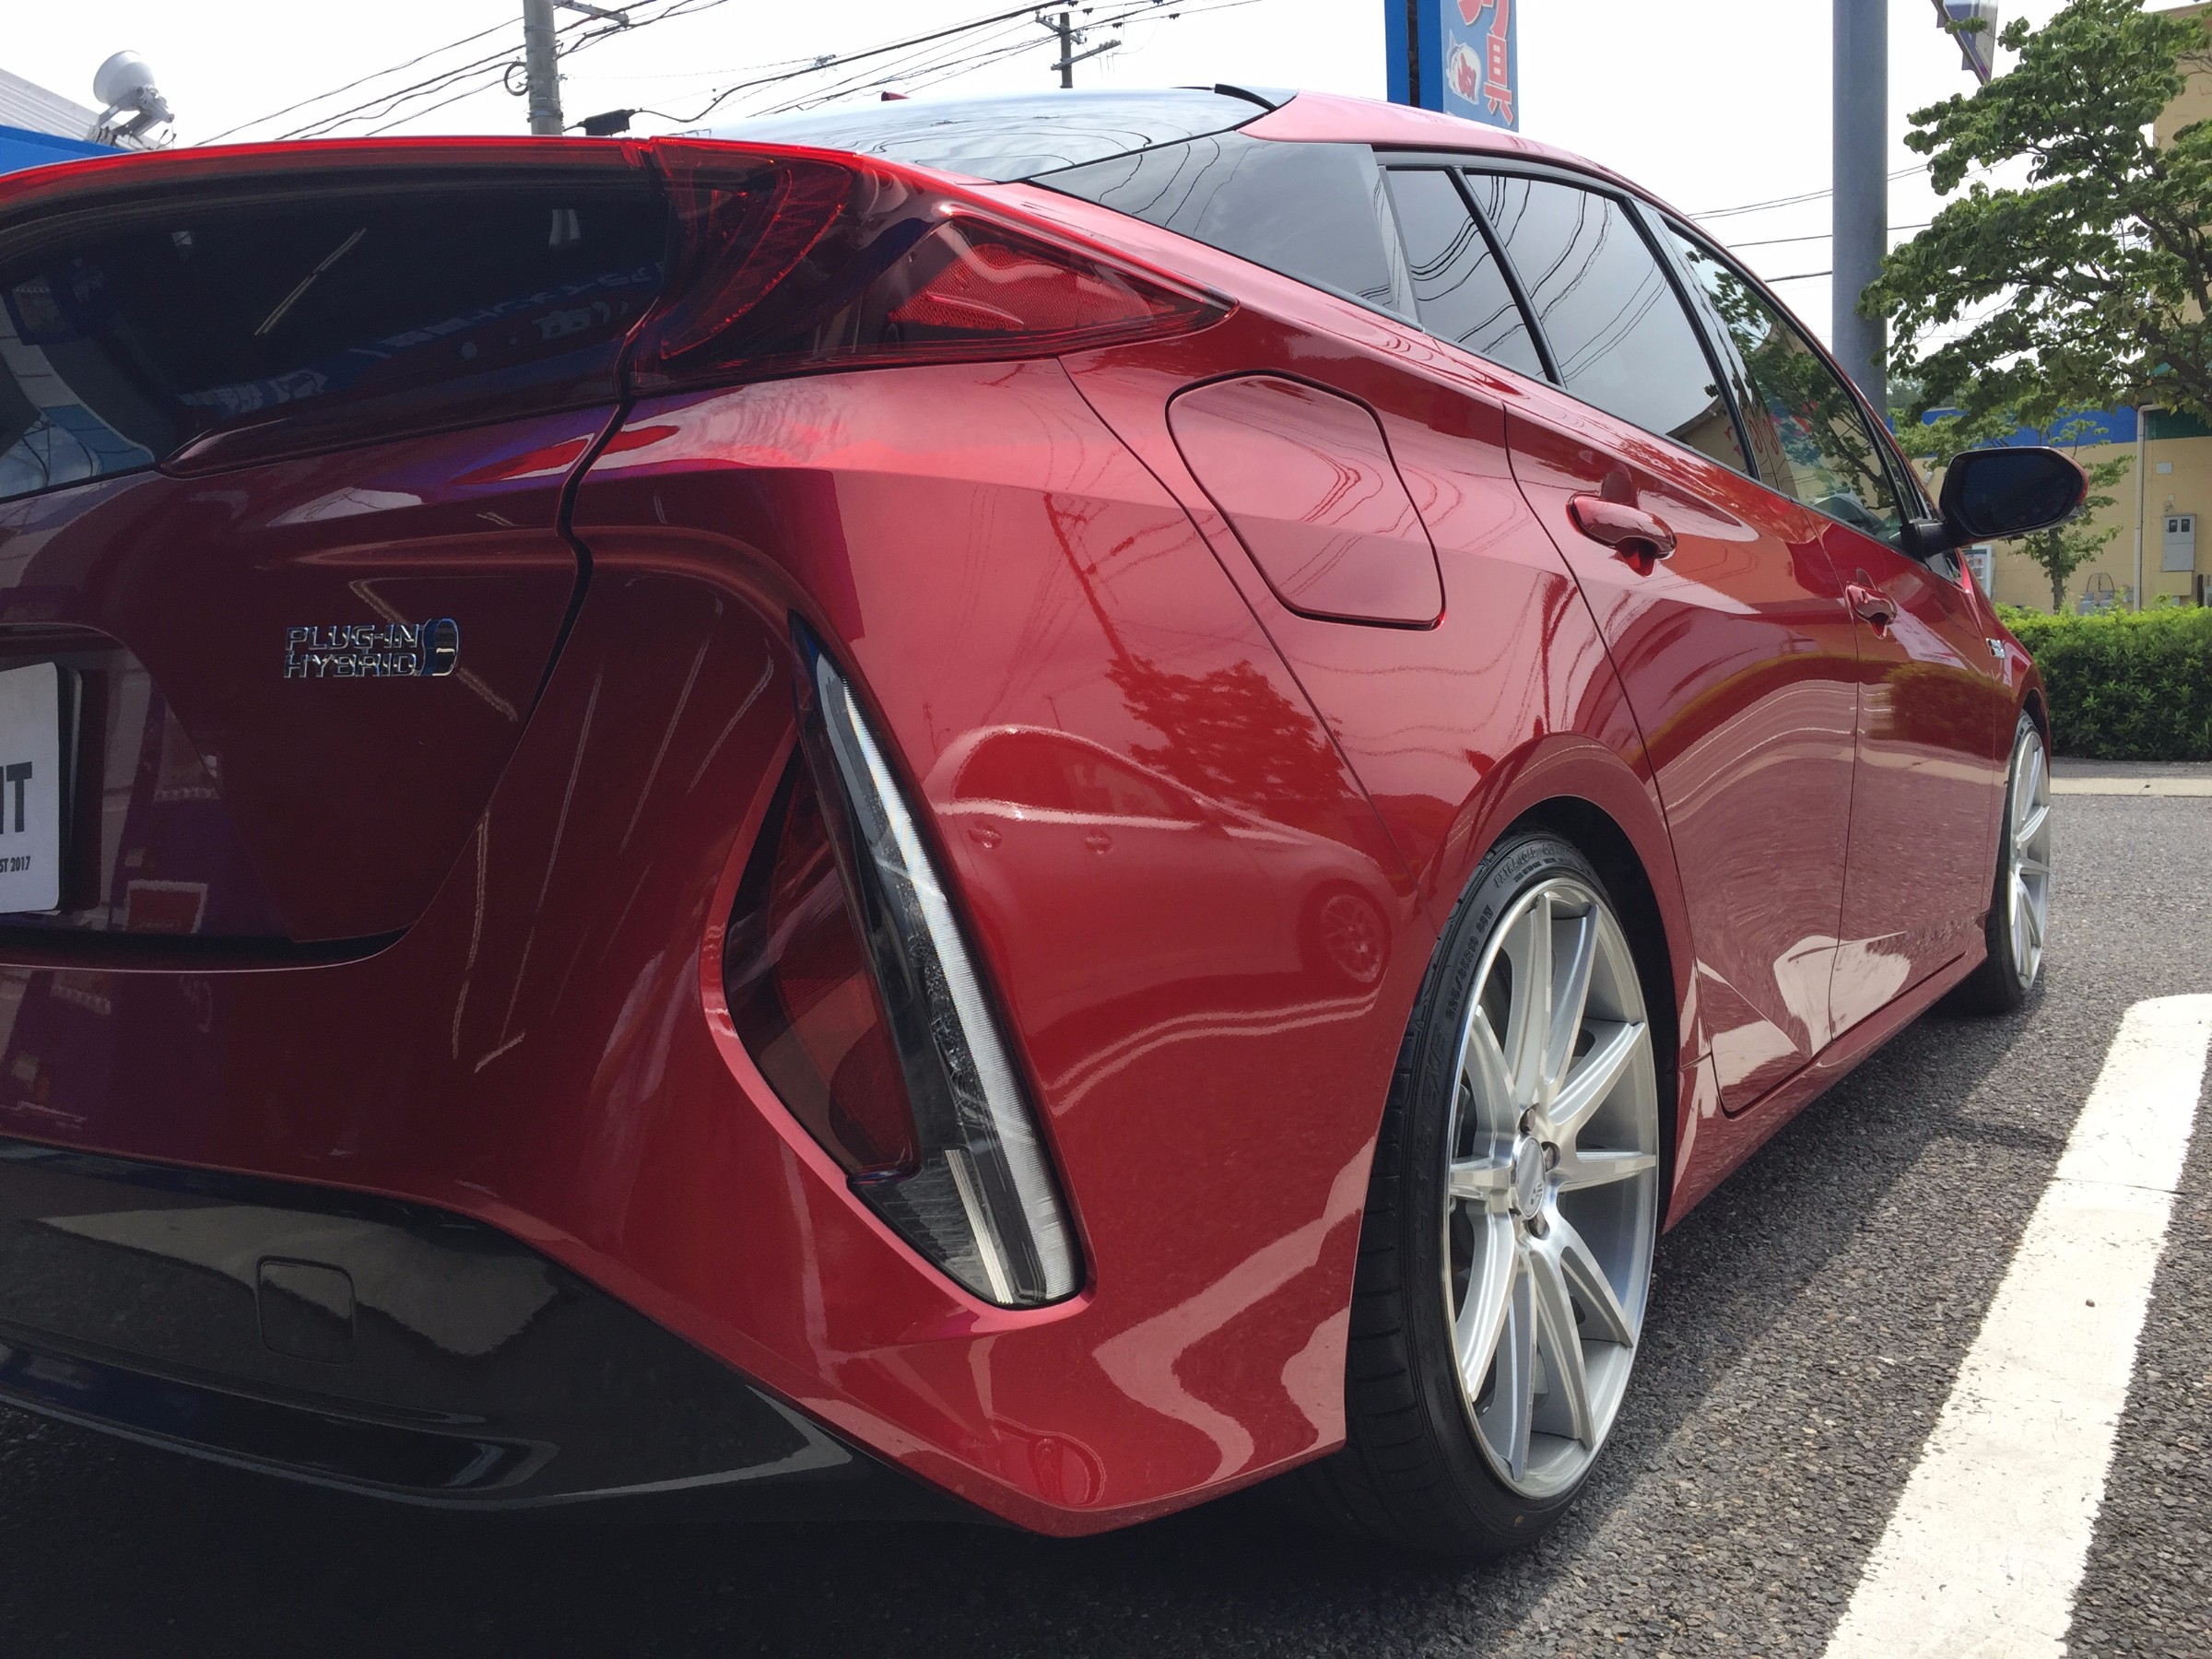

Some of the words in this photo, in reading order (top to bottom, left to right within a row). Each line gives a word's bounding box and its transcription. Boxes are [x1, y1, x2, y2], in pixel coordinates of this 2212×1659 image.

[285, 624, 420, 651] PLUG-IN
[283, 653, 418, 678] HYBRID
[10, 855, 31, 872] 2017
